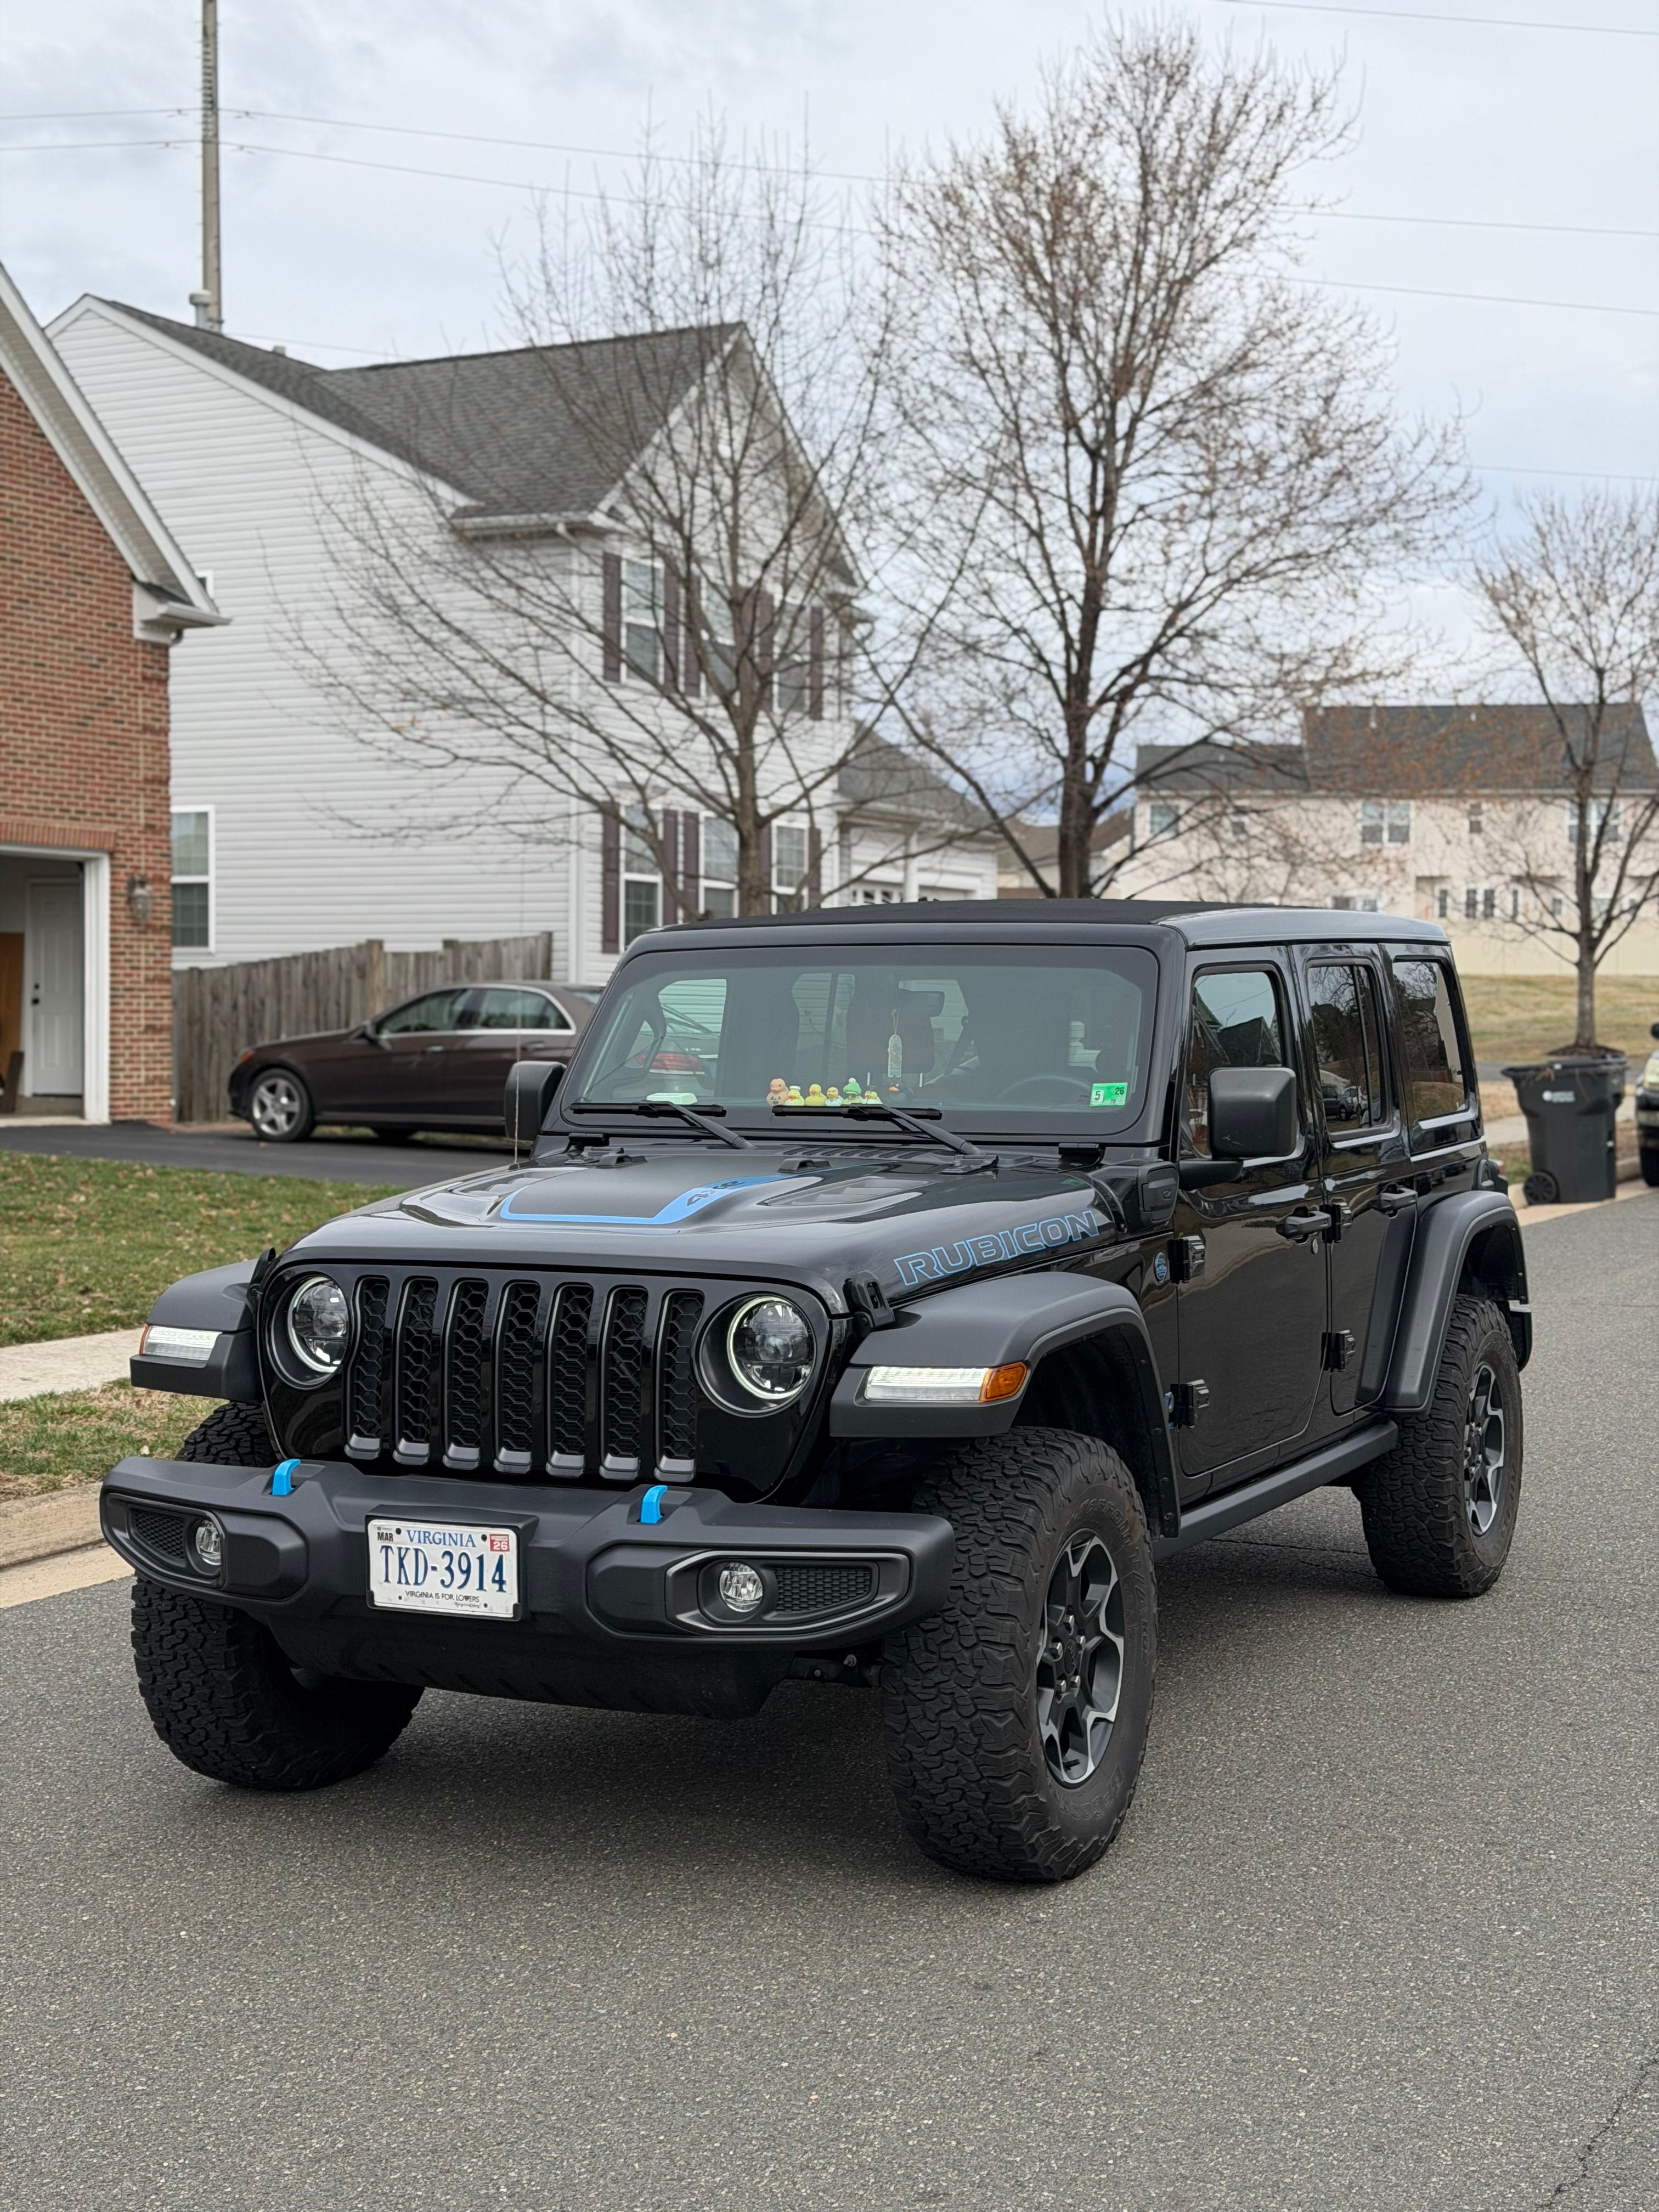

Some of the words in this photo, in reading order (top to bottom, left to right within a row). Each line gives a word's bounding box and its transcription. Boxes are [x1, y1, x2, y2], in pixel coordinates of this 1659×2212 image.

[1094, 1091, 1101, 1101] 5
[1114, 1087, 1125, 1095] 26
[894, 1210, 1099, 1286] RUBICON
[377, 1532, 394, 1543] MAR
[406, 1530, 477, 1548] VIRGINIA
[493, 1541, 508, 1551] 26
[379, 1545, 507, 1593] TKD-3914
[405, 1590, 434, 1599] VIRGINIA
[441, 1593, 454, 1601] FOR
